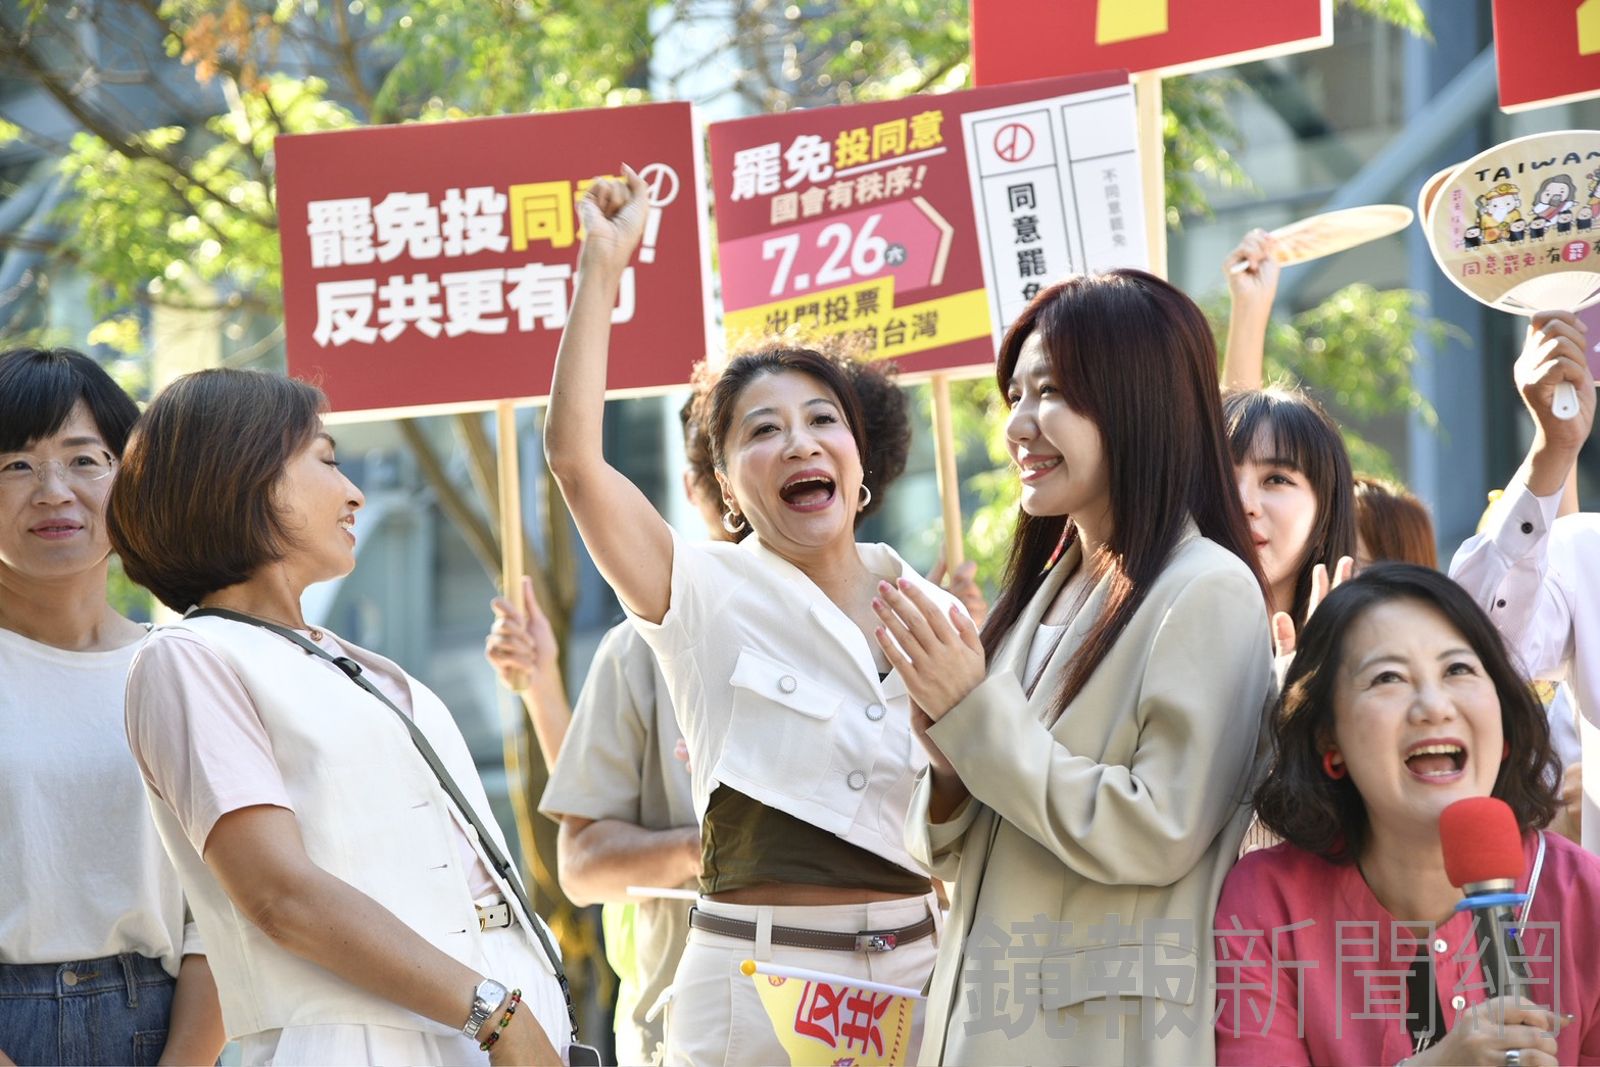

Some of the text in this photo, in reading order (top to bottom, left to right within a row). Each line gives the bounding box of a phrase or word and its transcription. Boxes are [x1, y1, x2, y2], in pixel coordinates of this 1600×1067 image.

[730, 110, 944, 202] 罷免投同意
[770, 164, 927, 226] 國會有秩序!
[307, 174, 662, 269] 罷免投同!
[762, 214, 887, 297] 7.26
[313, 262, 636, 348] 反共更有
[794, 980, 893, 1056] 反共
